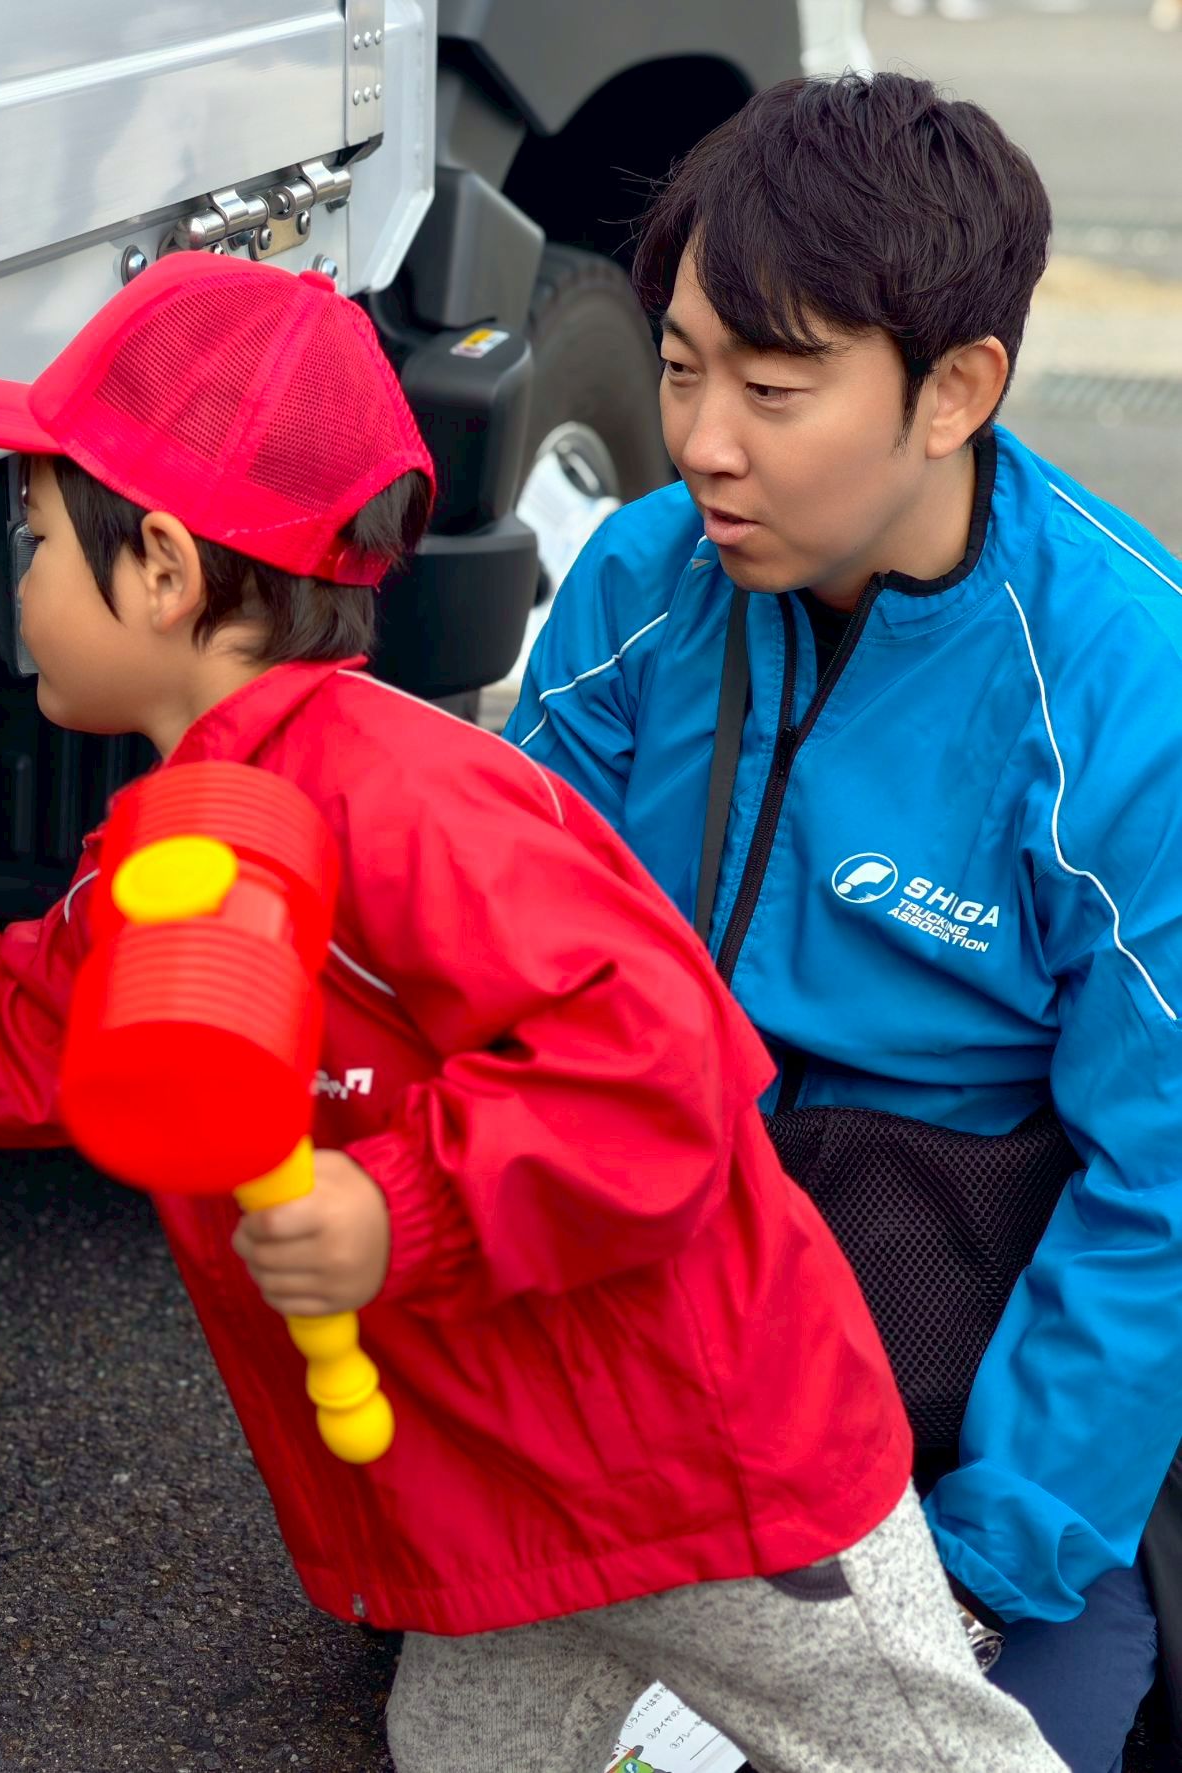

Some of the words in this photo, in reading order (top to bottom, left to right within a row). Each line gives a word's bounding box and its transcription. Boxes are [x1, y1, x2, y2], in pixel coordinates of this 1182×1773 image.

[898, 897, 970, 937] TRUCKING
[903, 876, 1000, 928] SHIGA
[887, 907, 990, 953] ASSOCIATION
